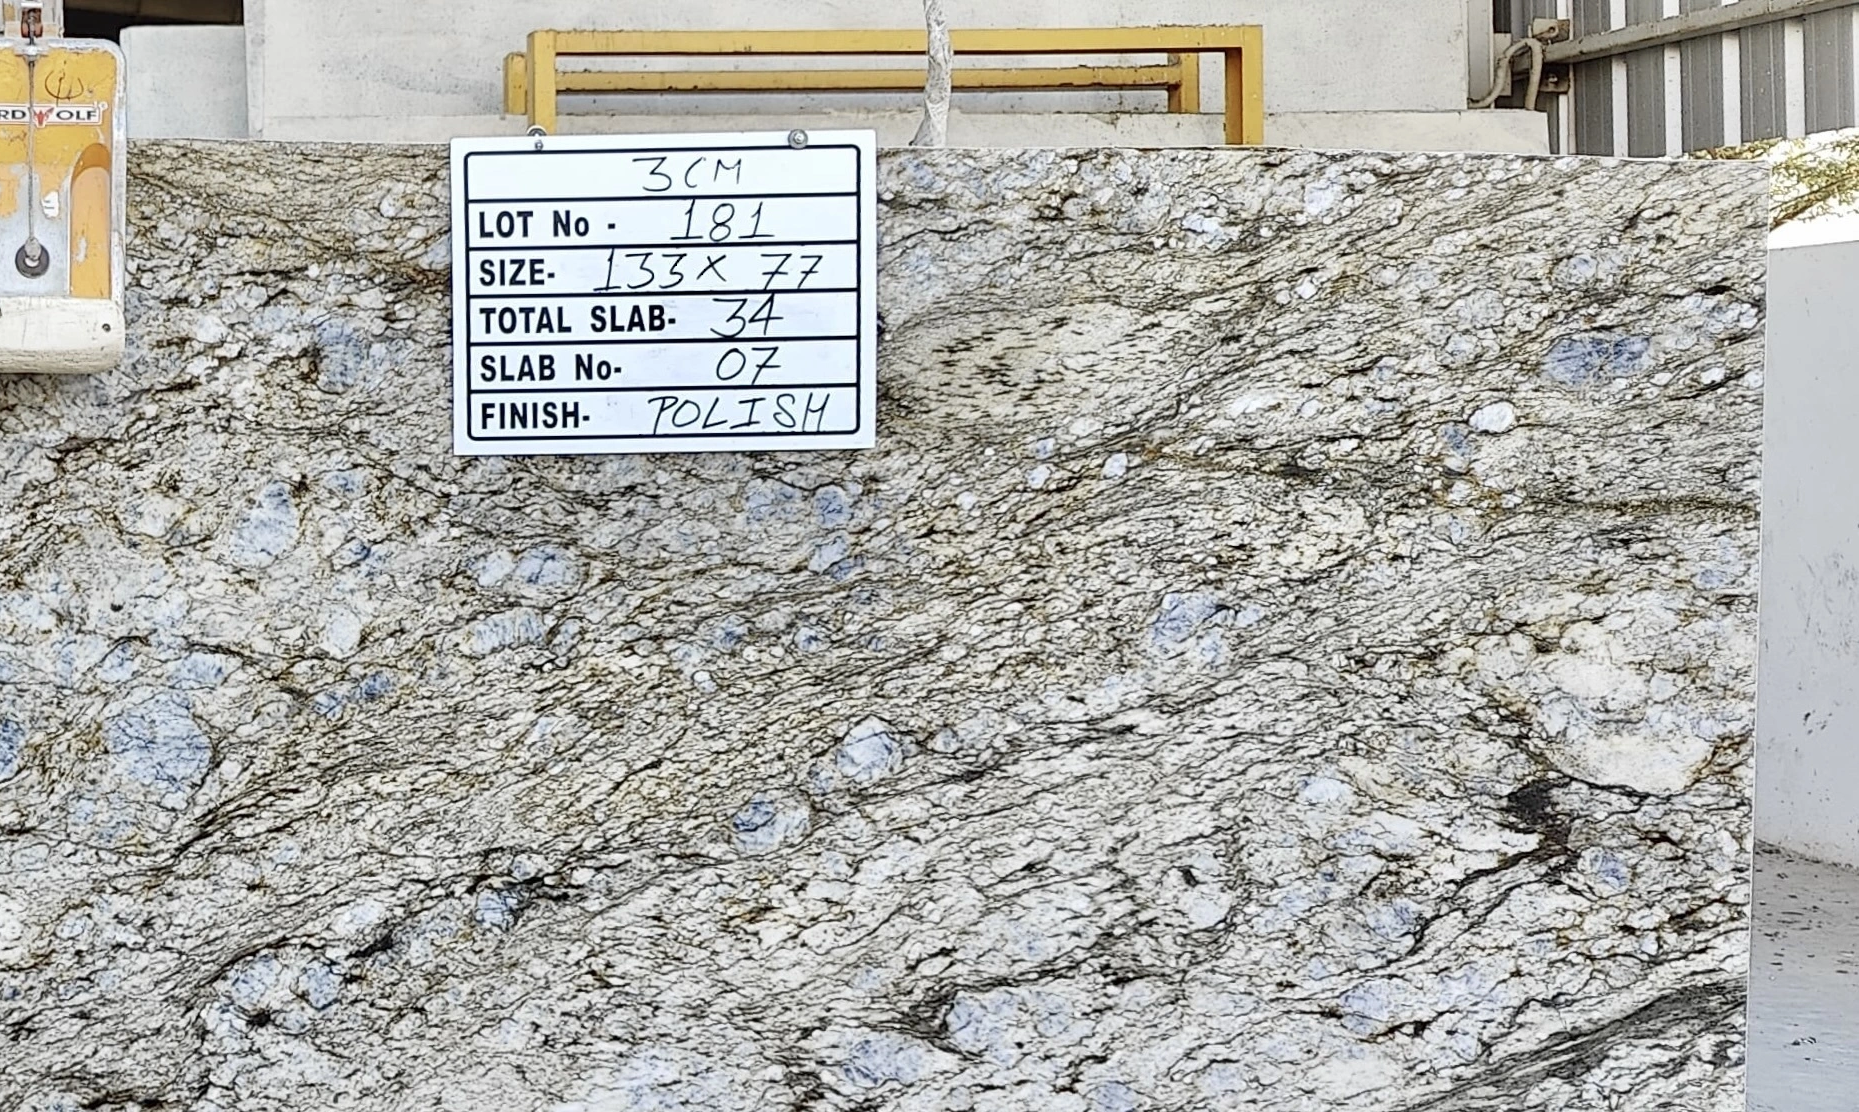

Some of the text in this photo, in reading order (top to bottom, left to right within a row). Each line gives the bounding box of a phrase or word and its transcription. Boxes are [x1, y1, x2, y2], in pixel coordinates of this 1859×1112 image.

[479, 211, 534, 238] LOT
[670, 198, 775, 241] 181
[479, 306, 572, 335] TOTAL
[710, 293, 784, 339] 34
[480, 354, 556, 382] SLAB
[715, 347, 782, 386] 07
[648, 392, 831, 435] POLISH
